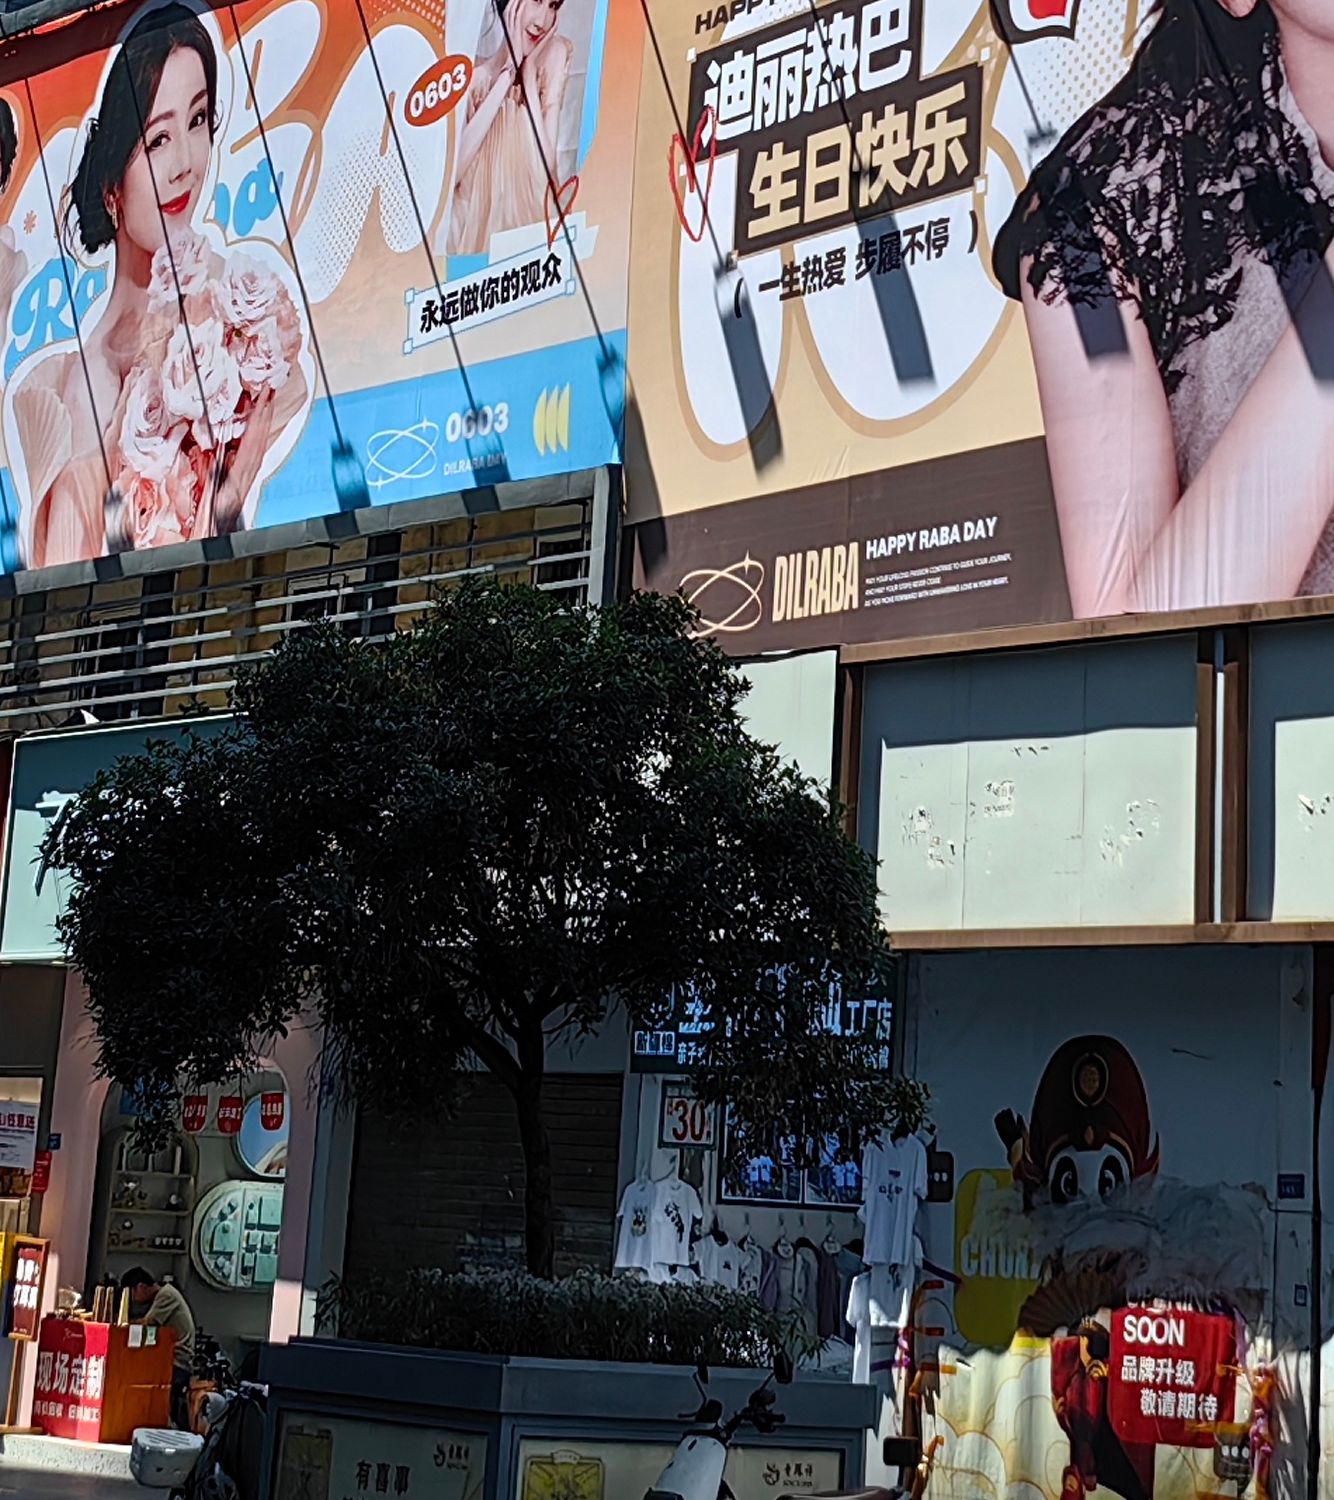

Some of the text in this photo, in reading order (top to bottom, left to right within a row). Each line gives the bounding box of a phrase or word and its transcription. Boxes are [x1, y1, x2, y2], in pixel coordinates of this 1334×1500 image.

[409, 63, 468, 118] 0603
[747, 81, 969, 239] 生日快乐
[757, 217, 951, 302] 一生热爱 步履不停
[420, 253, 562, 333] 永远做你的观众
[445, 402, 509, 442] 0603
[866, 516, 998, 560] HAPPY RABA DAY
[771, 540, 859, 622] DILRABA
[1123, 1314, 1185, 1346] SOON
[37, 1350, 105, 1400] 现场定制
[1121, 1355, 1195, 1387] 品牌升级
[1140, 1387, 1218, 1420] 敬请期待
